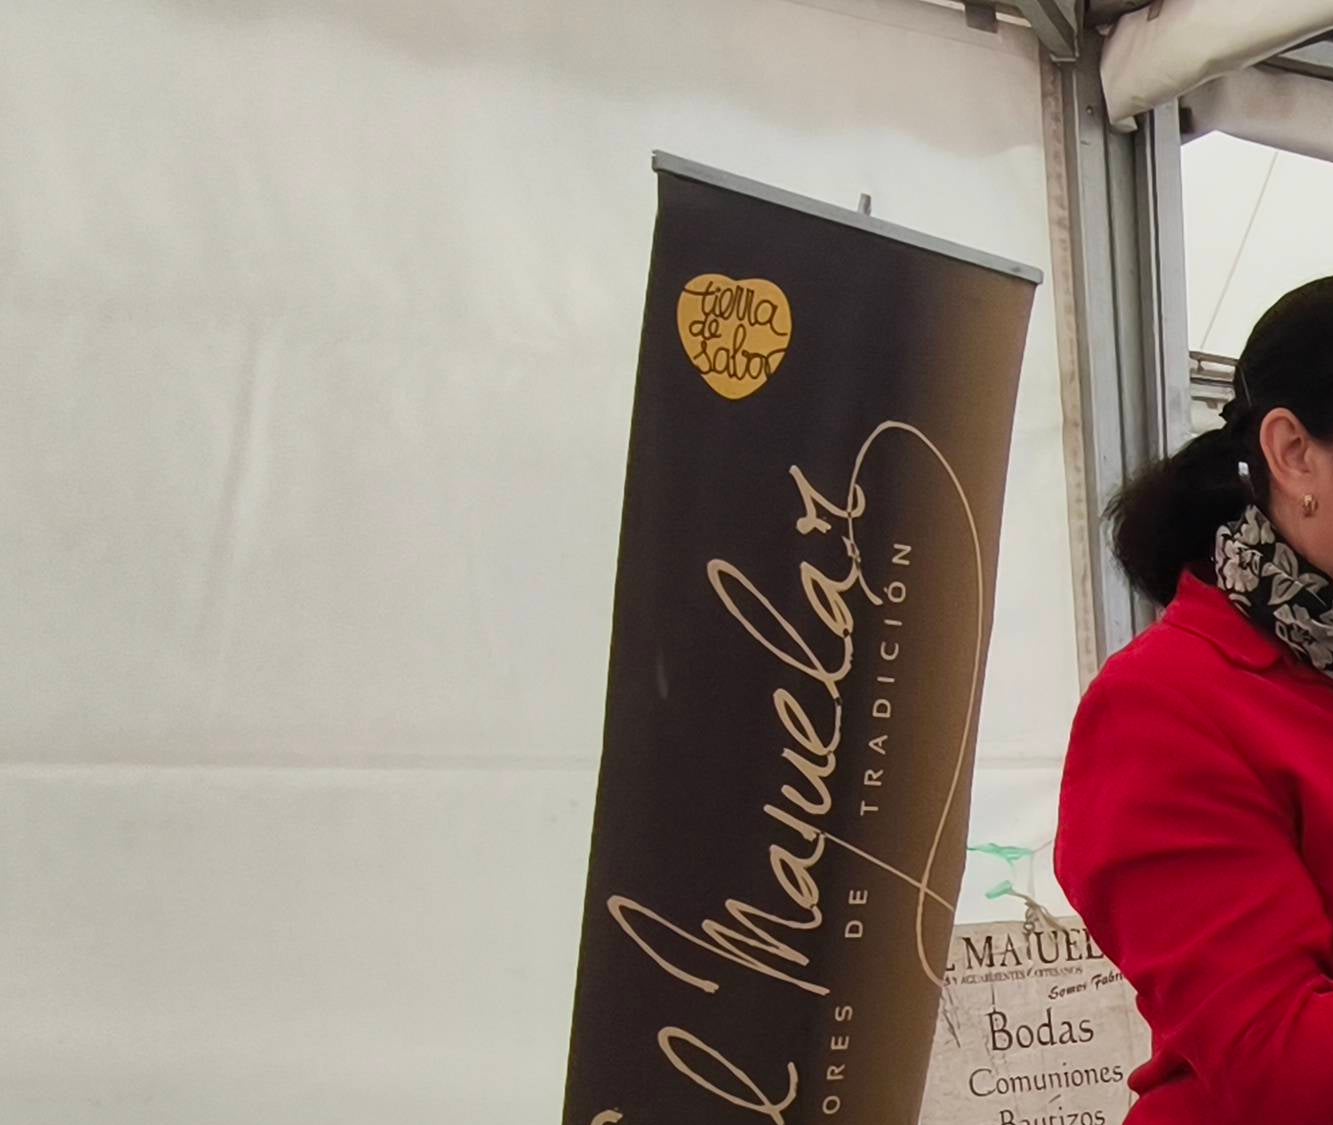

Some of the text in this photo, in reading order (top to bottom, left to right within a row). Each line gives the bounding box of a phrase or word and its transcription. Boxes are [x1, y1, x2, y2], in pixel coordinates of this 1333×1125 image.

[689, 319, 722, 341] de
[845, 888, 868, 939] DE
[860, 543, 912, 816] TRADICIÓN
[986, 1007, 1095, 1051] Bodas
[968, 1062, 1124, 1097] Comuniones
